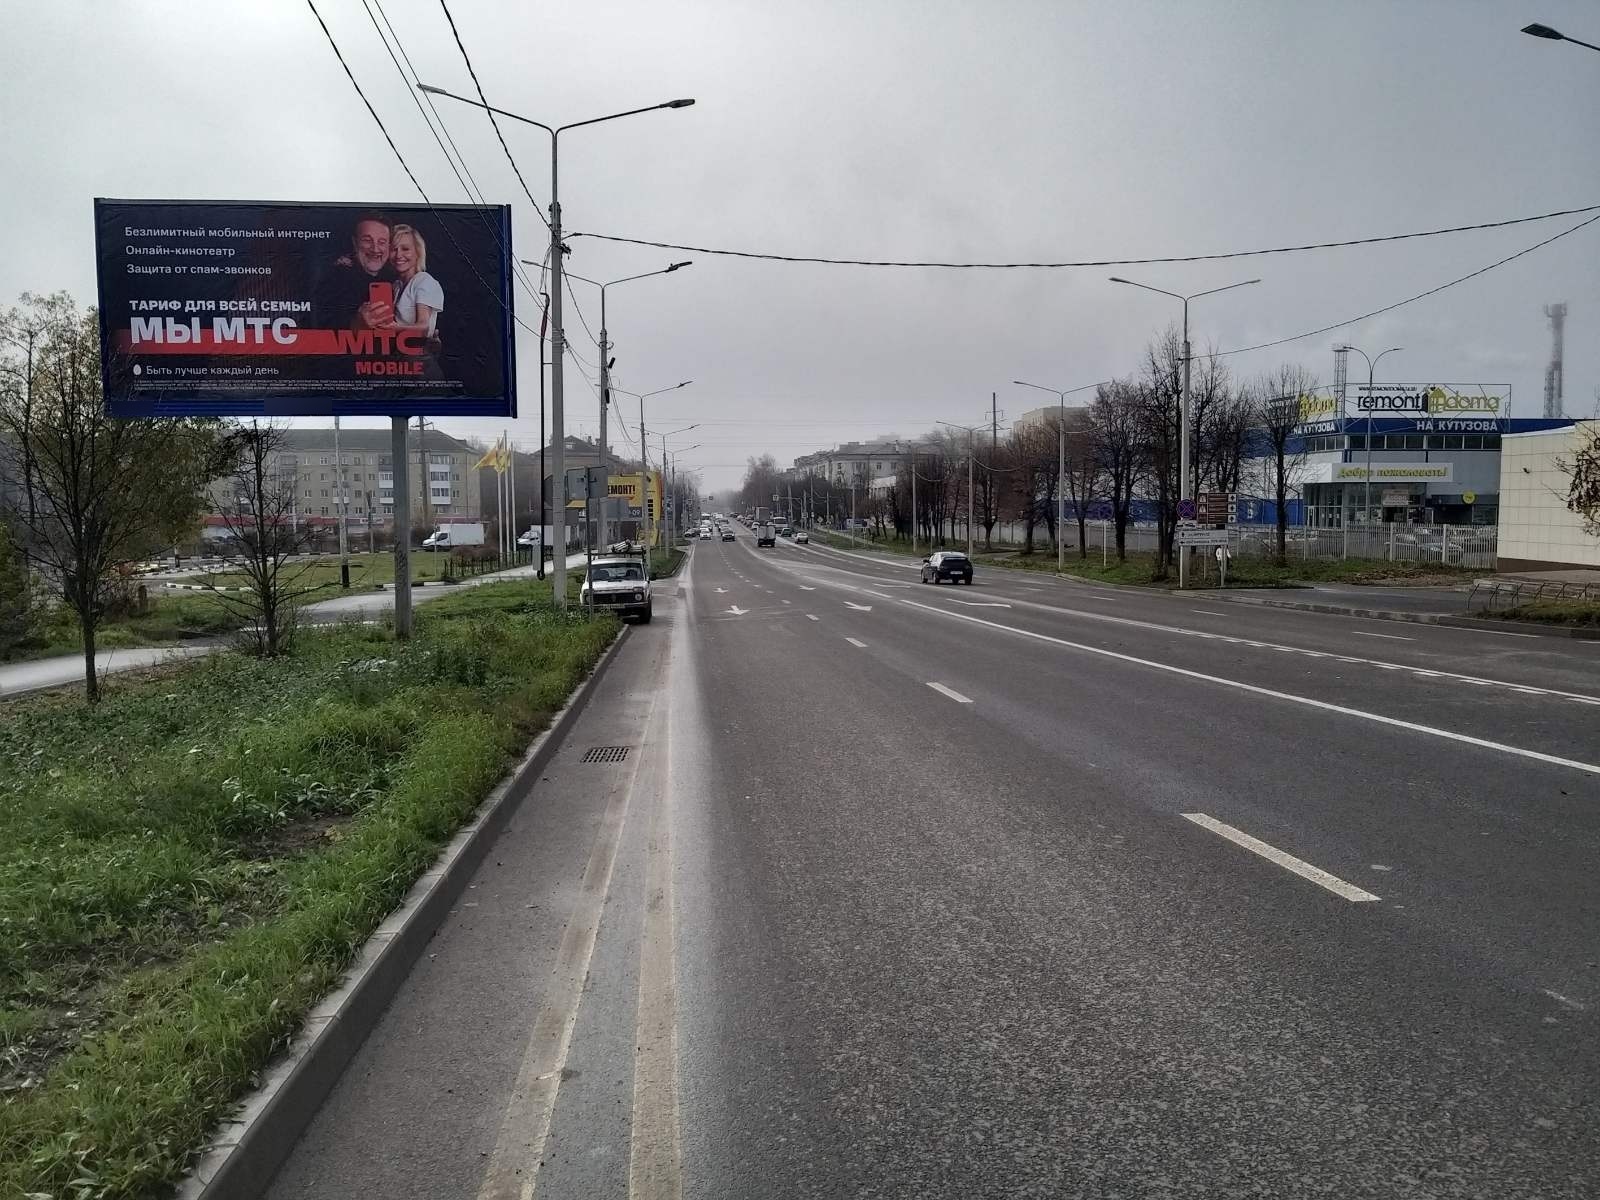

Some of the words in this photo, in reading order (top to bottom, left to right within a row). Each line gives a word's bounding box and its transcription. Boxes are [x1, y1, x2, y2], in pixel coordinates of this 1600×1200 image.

[125, 227, 205, 238] Безлимитный
[209, 228, 275, 238] мобильный
[278, 229, 331, 242] интернет
[126, 245, 236, 257] Онлайн-кинотеатр
[126, 264, 172, 275] Защита
[174, 265, 189, 275] от
[190, 265, 272, 276] спам-звонков
[129, 300, 182, 311] ТАРИФ
[184, 300, 216, 313] ДЛЯ
[219, 298, 258, 312] ВСЕЙ
[260, 300, 311, 313] СЕМЬИ
[130, 317, 201, 344] МЫ
[213, 317, 298, 345] МТС
[146, 365, 173, 376] Быть
[174, 366, 208, 377] лучше
[210, 364, 252, 377] каждый
[254, 366, 280, 377] день
[356, 360, 424, 376] MOBILE
[1358, 393, 1421, 409] remont
[1446, 391, 1500, 409] doma
[1416, 420, 1433, 432] НА
[1439, 421, 1498, 432] КУТУЗОВА
[608, 484, 635, 495] ЕМОНТ!
